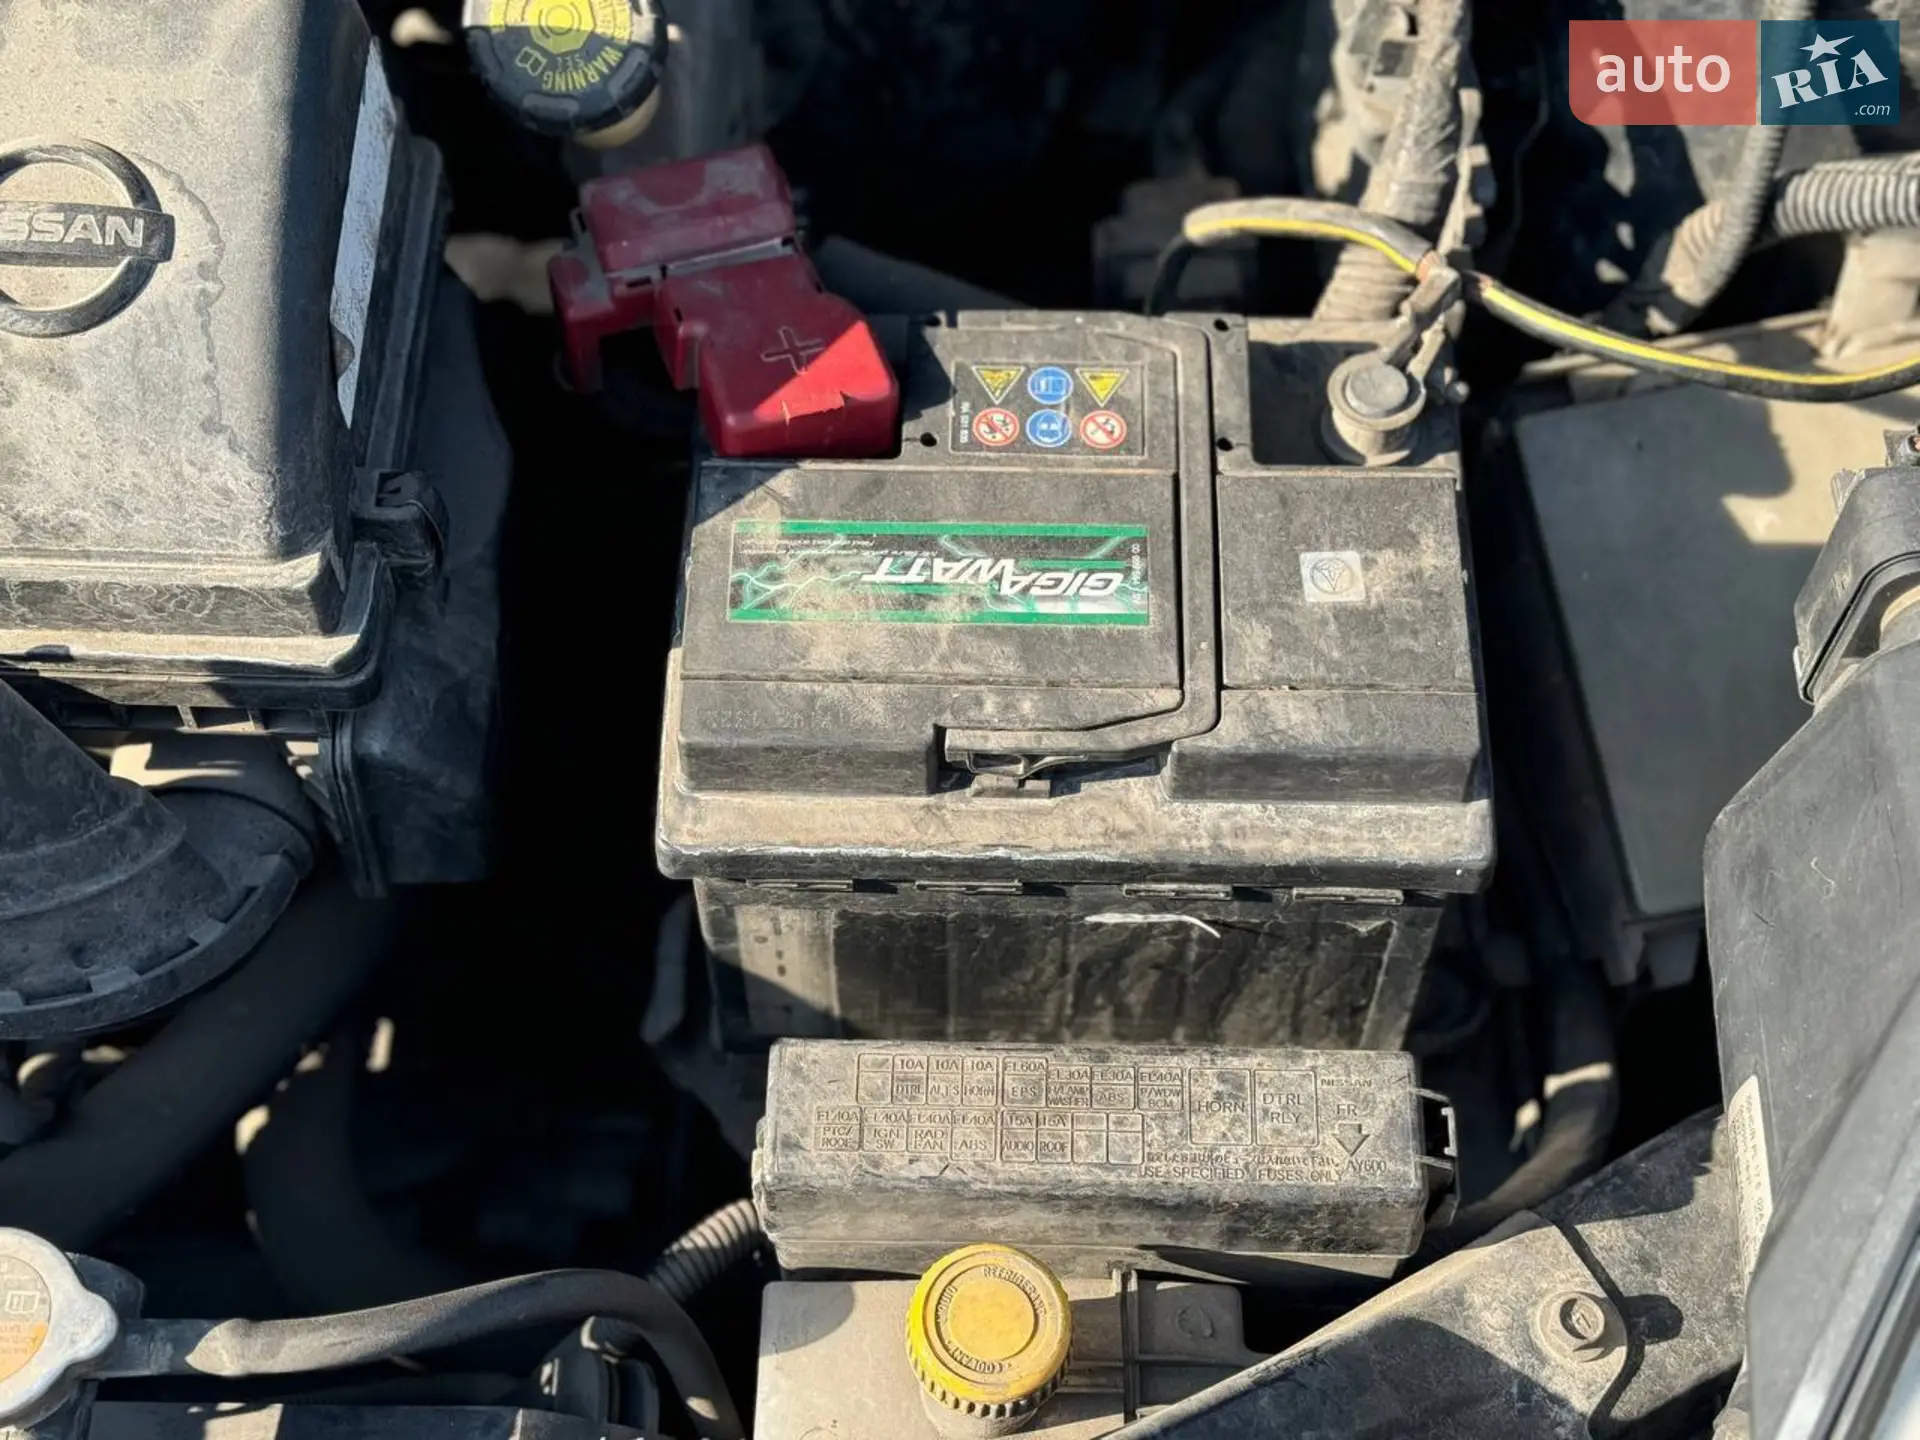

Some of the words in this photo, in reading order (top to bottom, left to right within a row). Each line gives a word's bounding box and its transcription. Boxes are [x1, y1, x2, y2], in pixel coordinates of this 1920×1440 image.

[541, 45, 624, 93] WARNING
[861, 556, 1125, 598] GIGAWATT
[900, 1058, 925, 1071] 10A
[935, 1059, 959, 1071] 10A
[971, 1060, 995, 1072] 10A
[1320, 1078, 1372, 1088] NISSAN
[1012, 1086, 1037, 1099] EPS
[1099, 1092, 1125, 1102] ABS
[1140, 1087, 1182, 1098] P/WDW
[1262, 1093, 1303, 1106] DTRL
[1197, 1100, 1245, 1113] HORN
[1336, 1103, 1358, 1117] FR
[1007, 1115, 1033, 1127] 15A
[1043, 1115, 1067, 1128] 15A
[1270, 1111, 1301, 1124] RLY
[873, 1128, 900, 1139] IGN
[914, 1128, 945, 1139] RAD
[875, 1139, 895, 1150] SW
[914, 1140, 943, 1151] FAN
[958, 1139, 988, 1151] ABS
[1002, 1140, 1034, 1152] AUDIO
[1039, 1141, 1070, 1153] ROOF
[1139, 1166, 1163, 1178] USE
[1172, 1167, 1246, 1180] SPECIFIED
[1258, 1169, 1305, 1181] FUSES
[1309, 1168, 1344, 1182] ONLY
